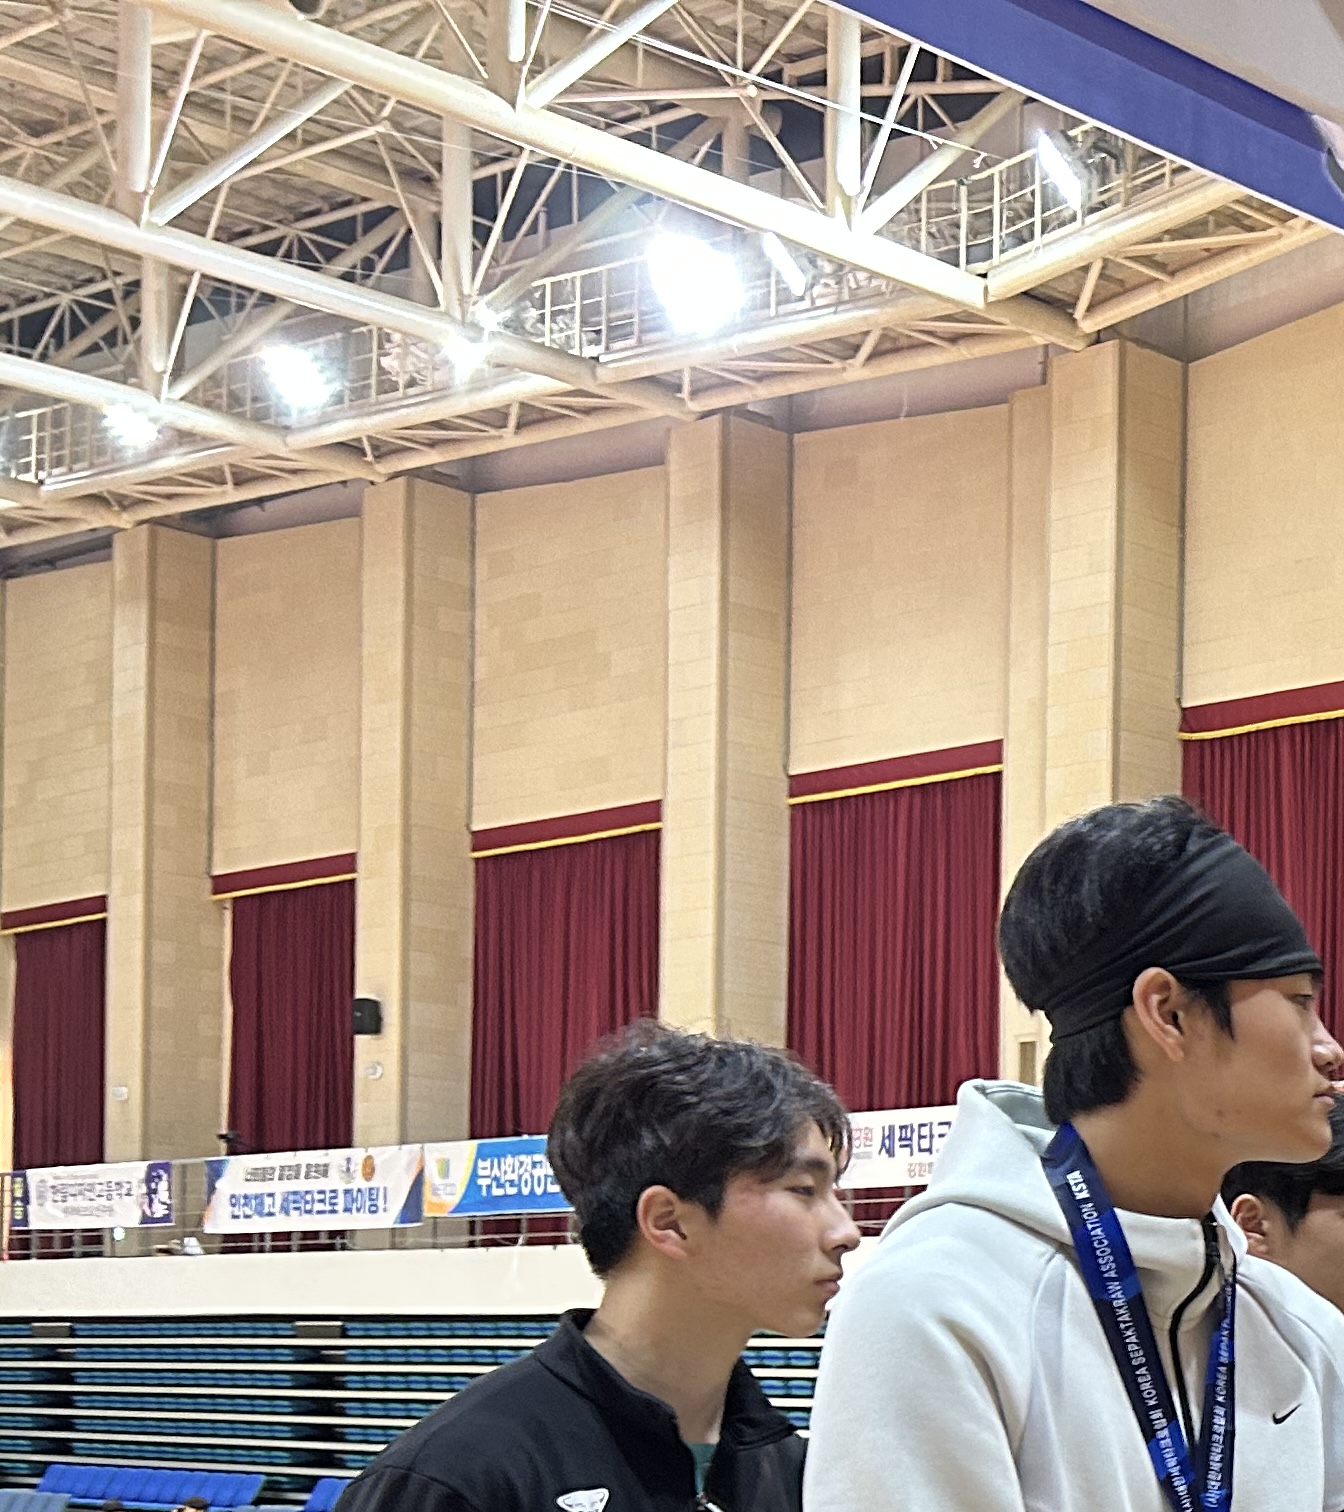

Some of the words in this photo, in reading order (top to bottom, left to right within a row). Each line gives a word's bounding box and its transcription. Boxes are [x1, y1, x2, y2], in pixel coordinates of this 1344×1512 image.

[1065, 1168, 1091, 1201] KSTA
[1079, 1200, 1119, 1281] ASSOCIATION
[1106, 1278, 1147, 1366] SEPAKTAKRAW
[1135, 1365, 1160, 1407] KOREA
